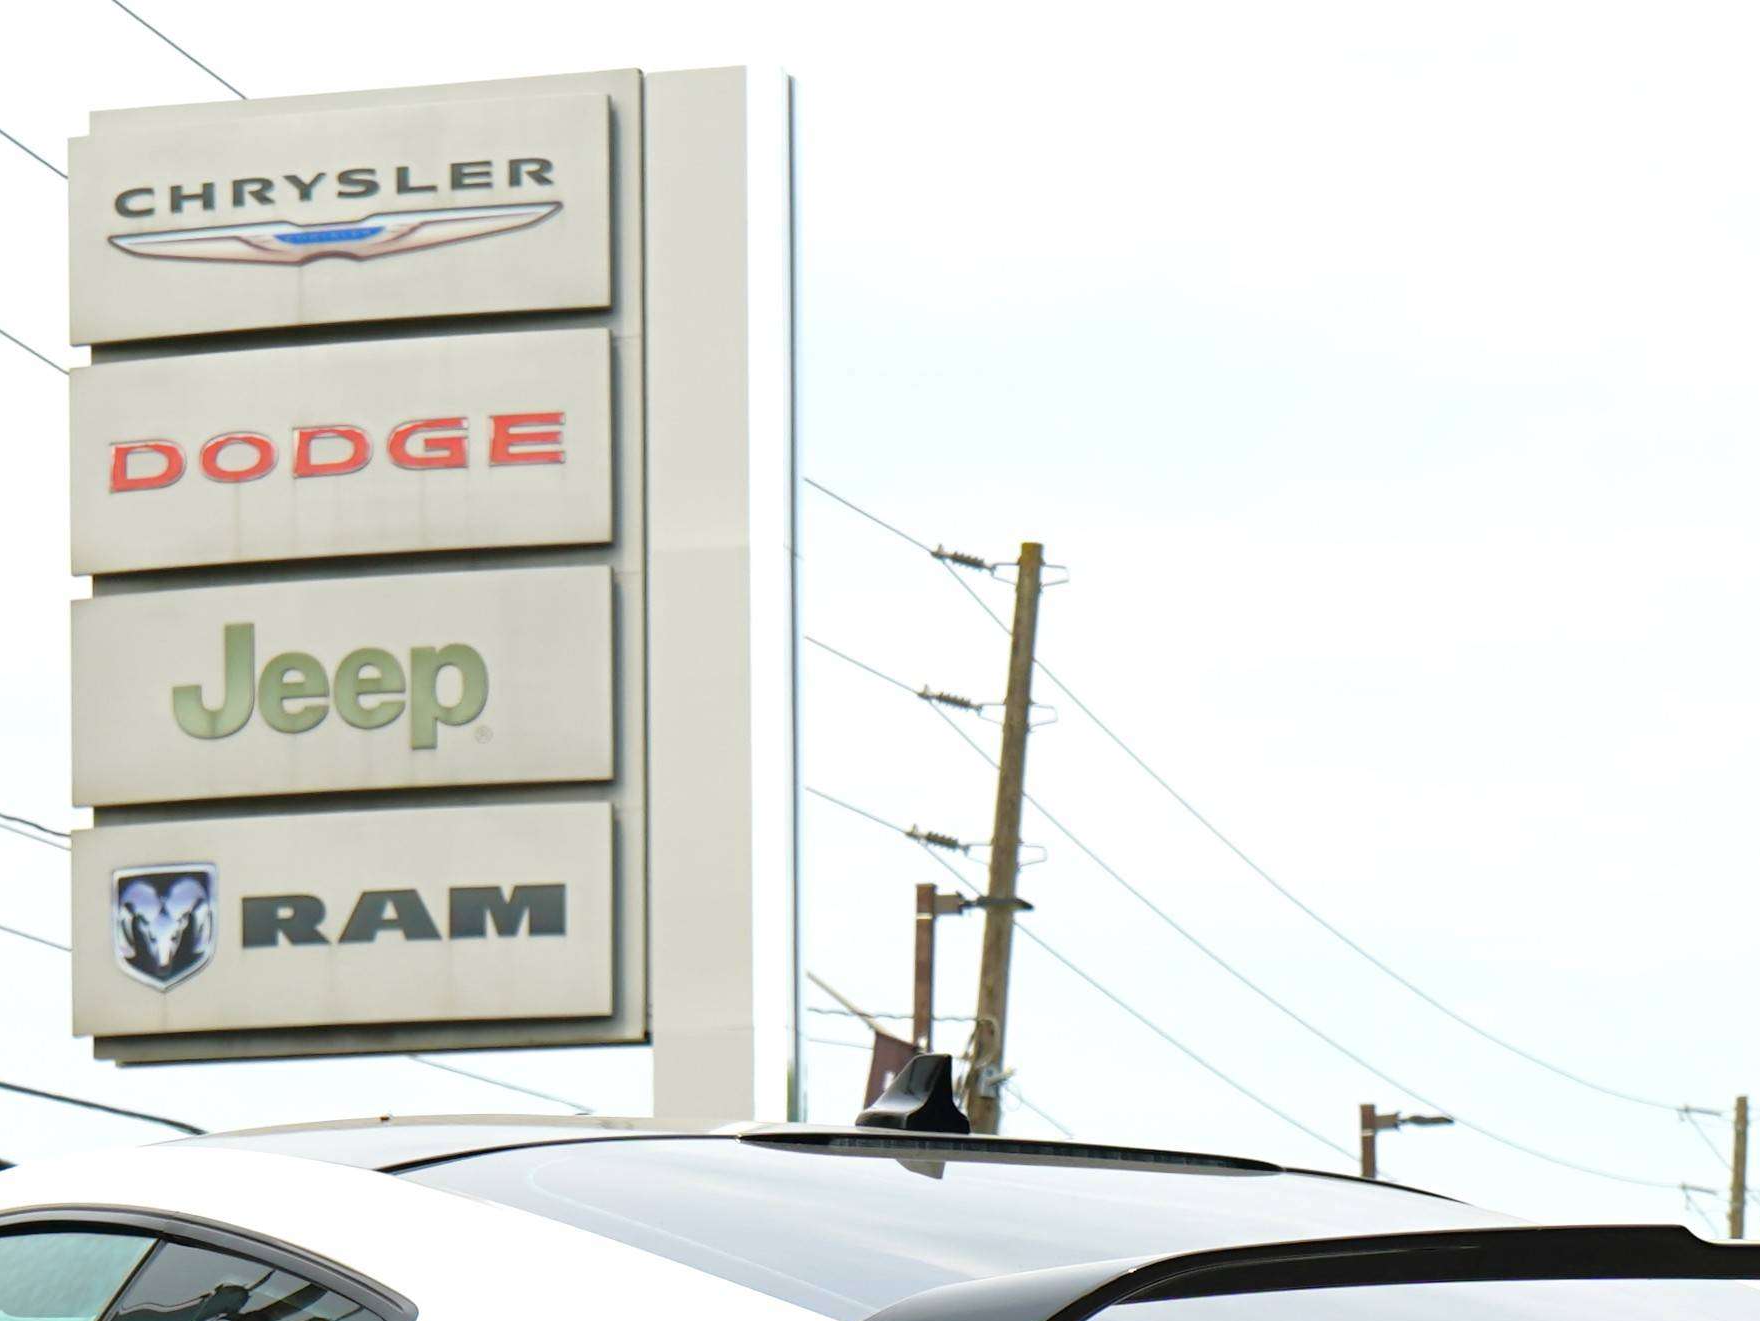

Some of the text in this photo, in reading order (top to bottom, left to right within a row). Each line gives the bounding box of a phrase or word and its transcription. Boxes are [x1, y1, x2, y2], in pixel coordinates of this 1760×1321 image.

[113, 156, 555, 219] CHRYSLER
[108, 411, 566, 494] DODGE
[172, 622, 490, 751] Jeep
[240, 883, 568, 949] RAM
